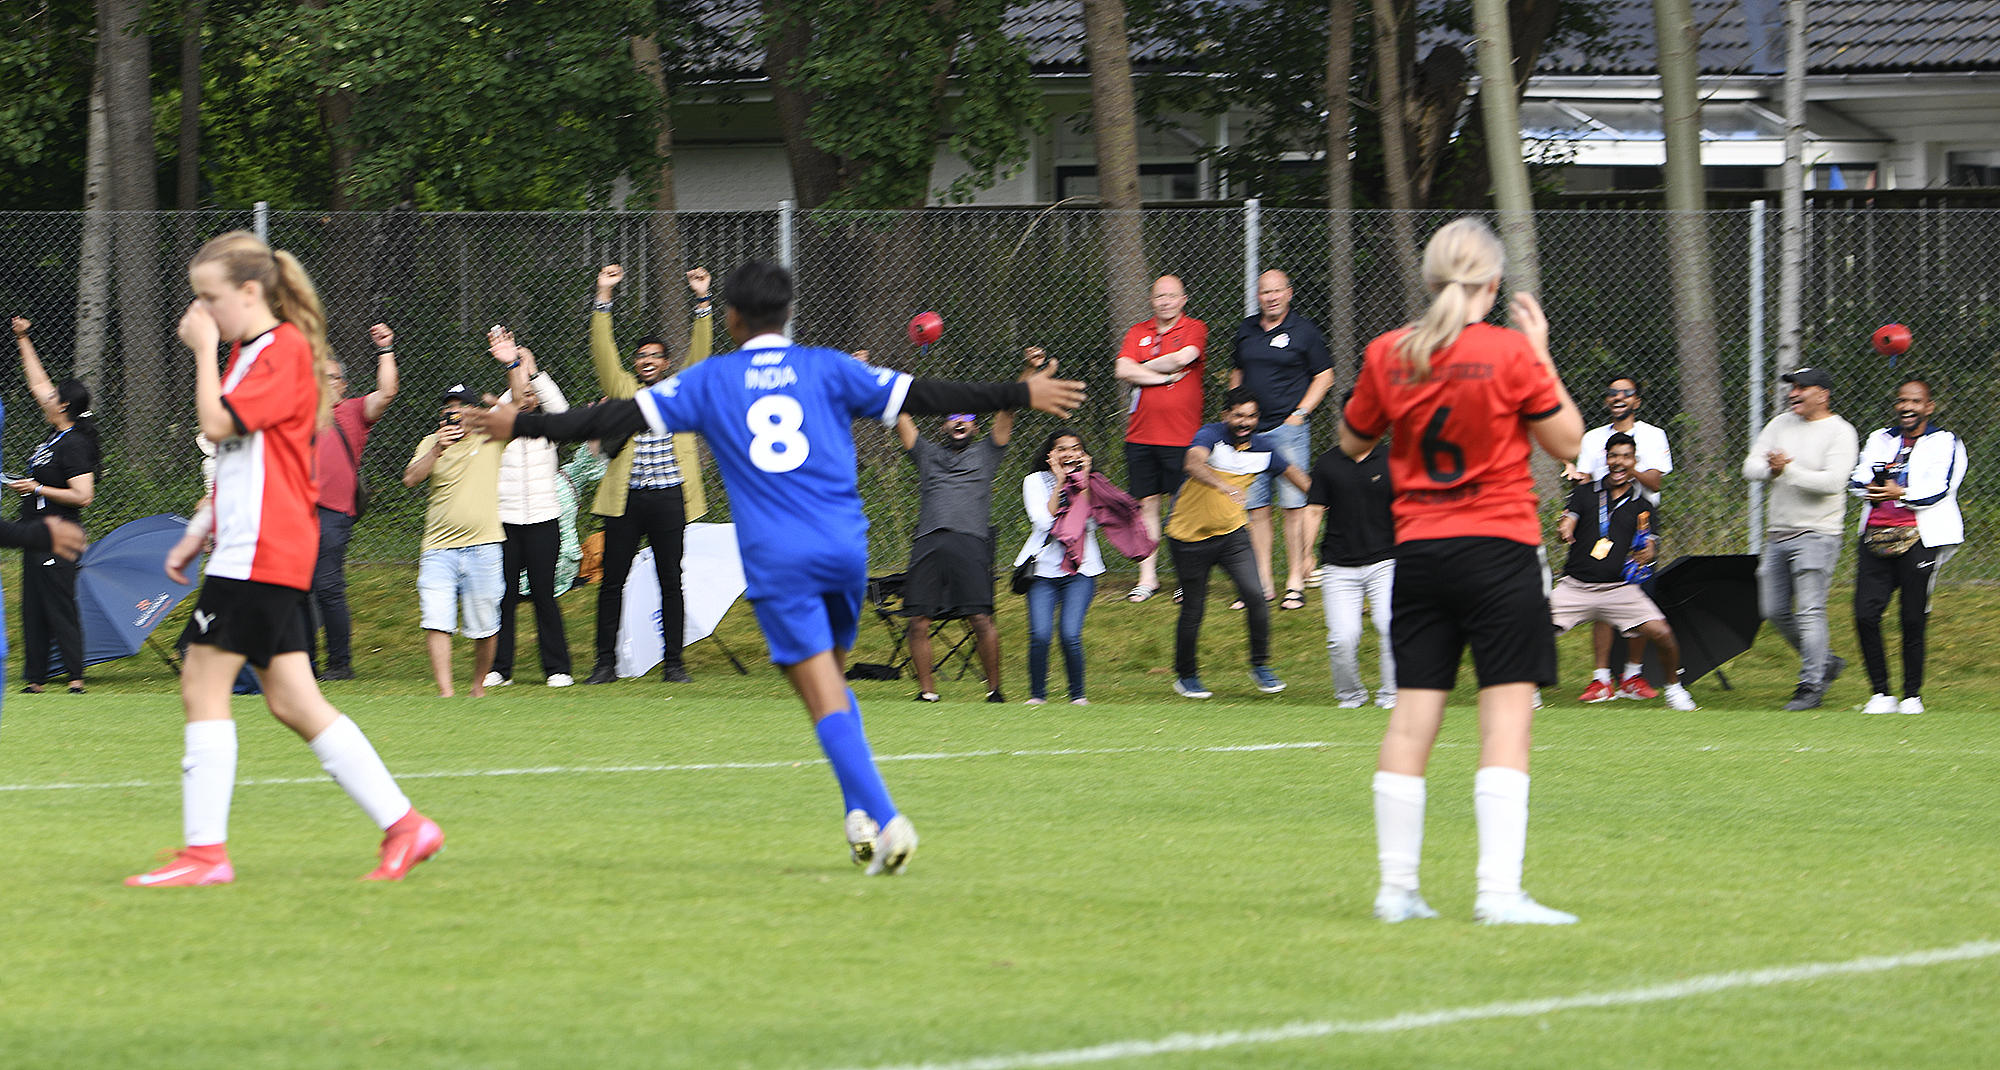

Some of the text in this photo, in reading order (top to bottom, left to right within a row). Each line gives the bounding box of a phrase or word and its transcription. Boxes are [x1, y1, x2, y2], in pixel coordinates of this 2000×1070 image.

[745, 366, 798, 390] INDIA
[746, 394, 809, 473] 8
[1420, 406, 1465, 482] 6
